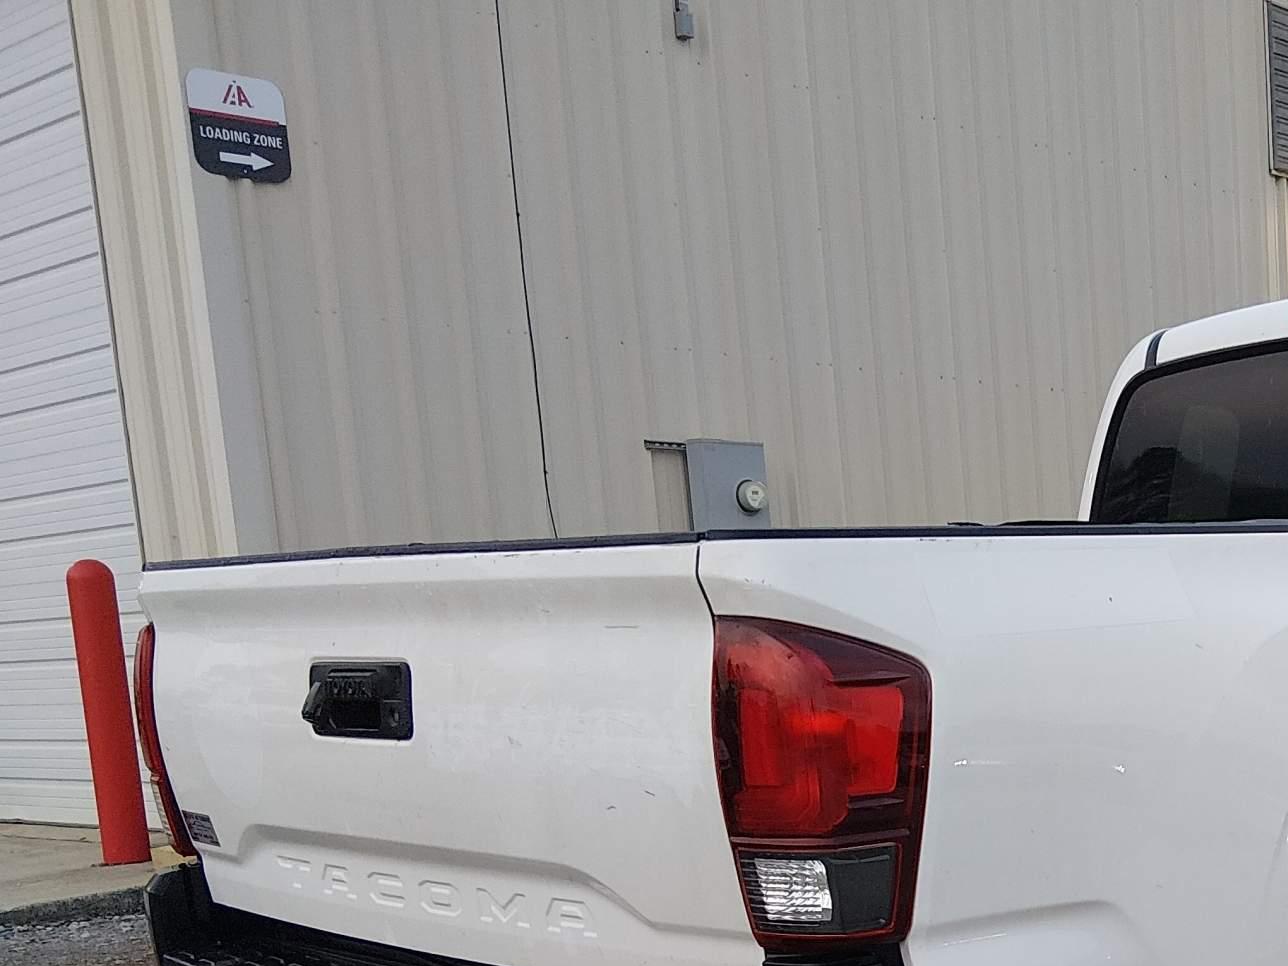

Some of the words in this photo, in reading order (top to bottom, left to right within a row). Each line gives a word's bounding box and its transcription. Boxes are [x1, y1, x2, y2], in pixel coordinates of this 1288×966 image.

[199, 125, 251, 145] LOADING
[253, 133, 283, 149] ZONE
[275, 855, 598, 938] TACOMA
